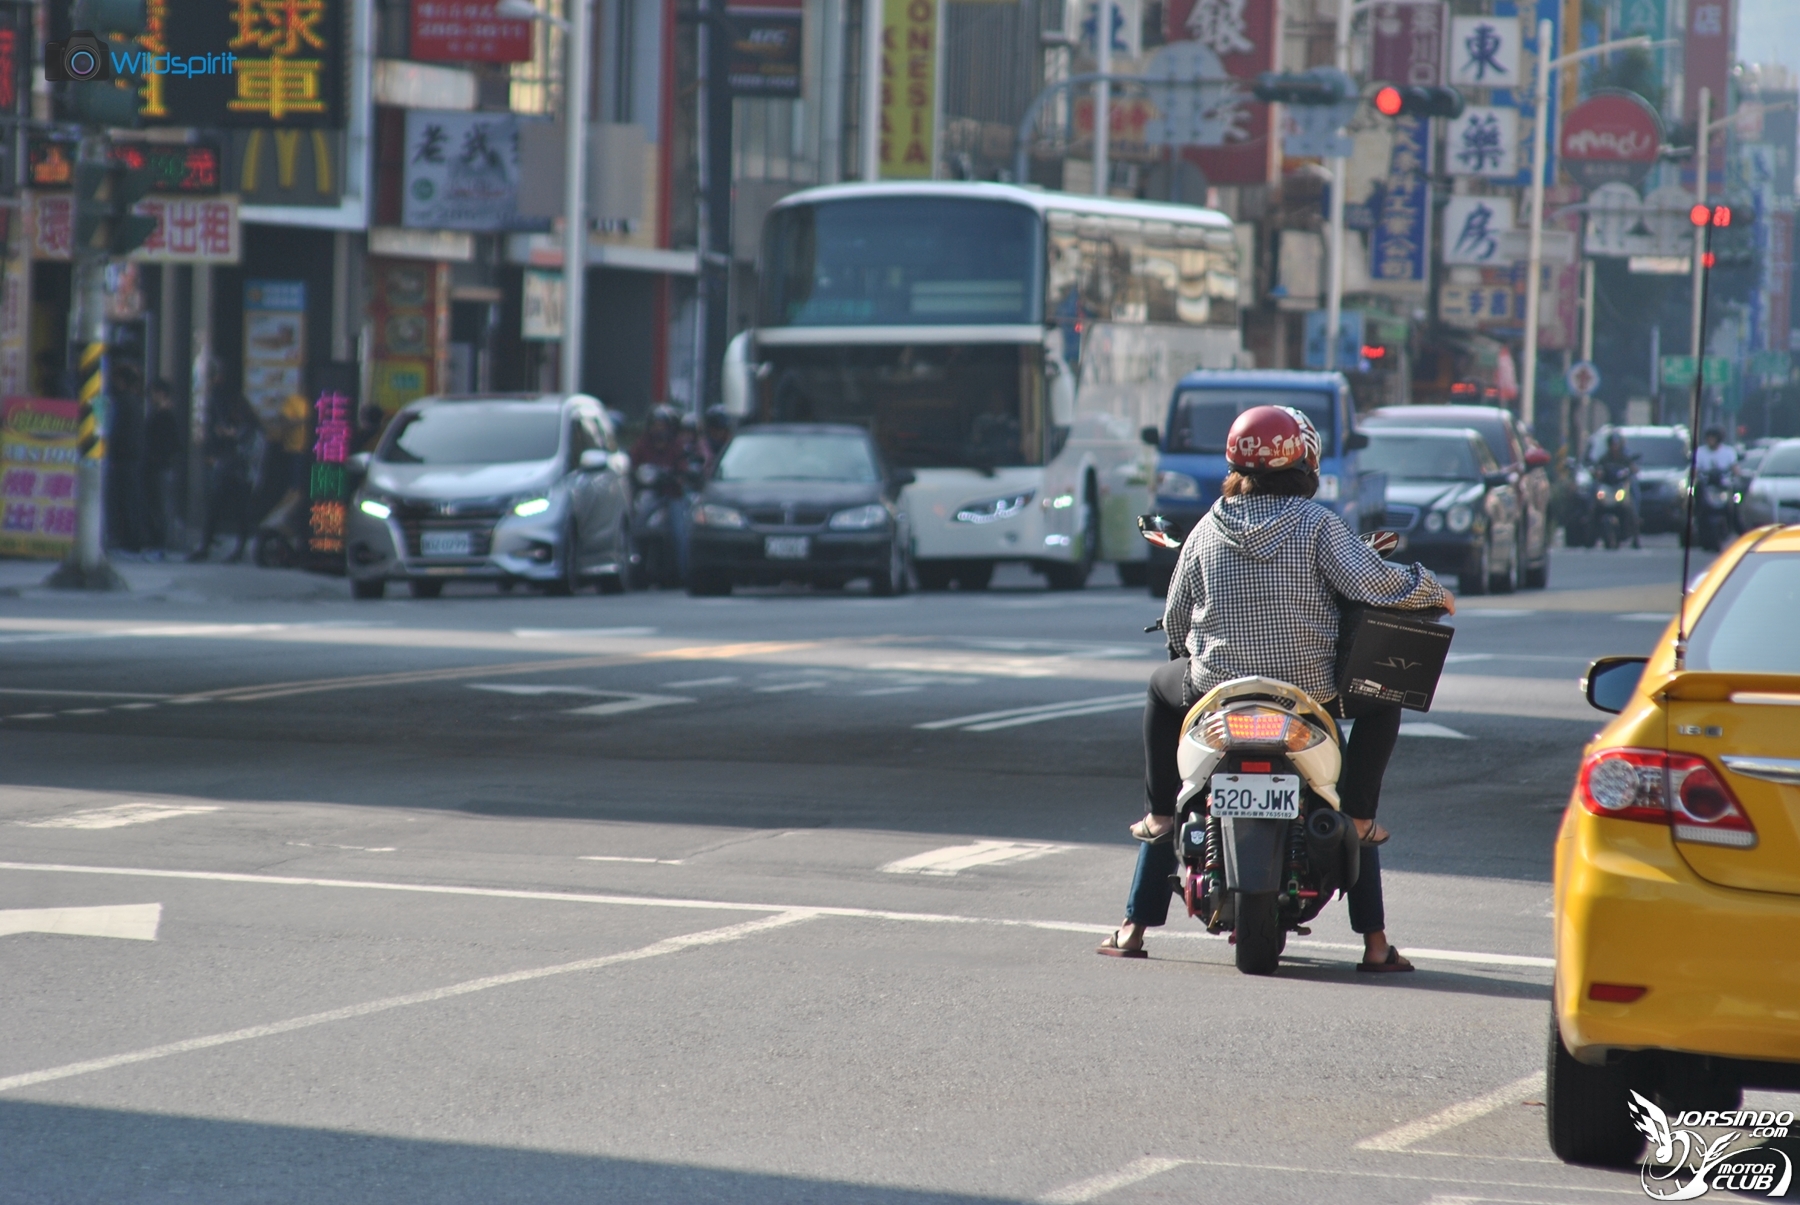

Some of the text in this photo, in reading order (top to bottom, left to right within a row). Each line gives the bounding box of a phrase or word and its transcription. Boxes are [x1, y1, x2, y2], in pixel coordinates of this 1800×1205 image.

[1692, 4, 1723, 36] 店
[1376, 621, 1398, 629] EXTREME
[1399, 625, 1428, 635] STANDARDS
[1428, 631, 1450, 639] HELMETS
